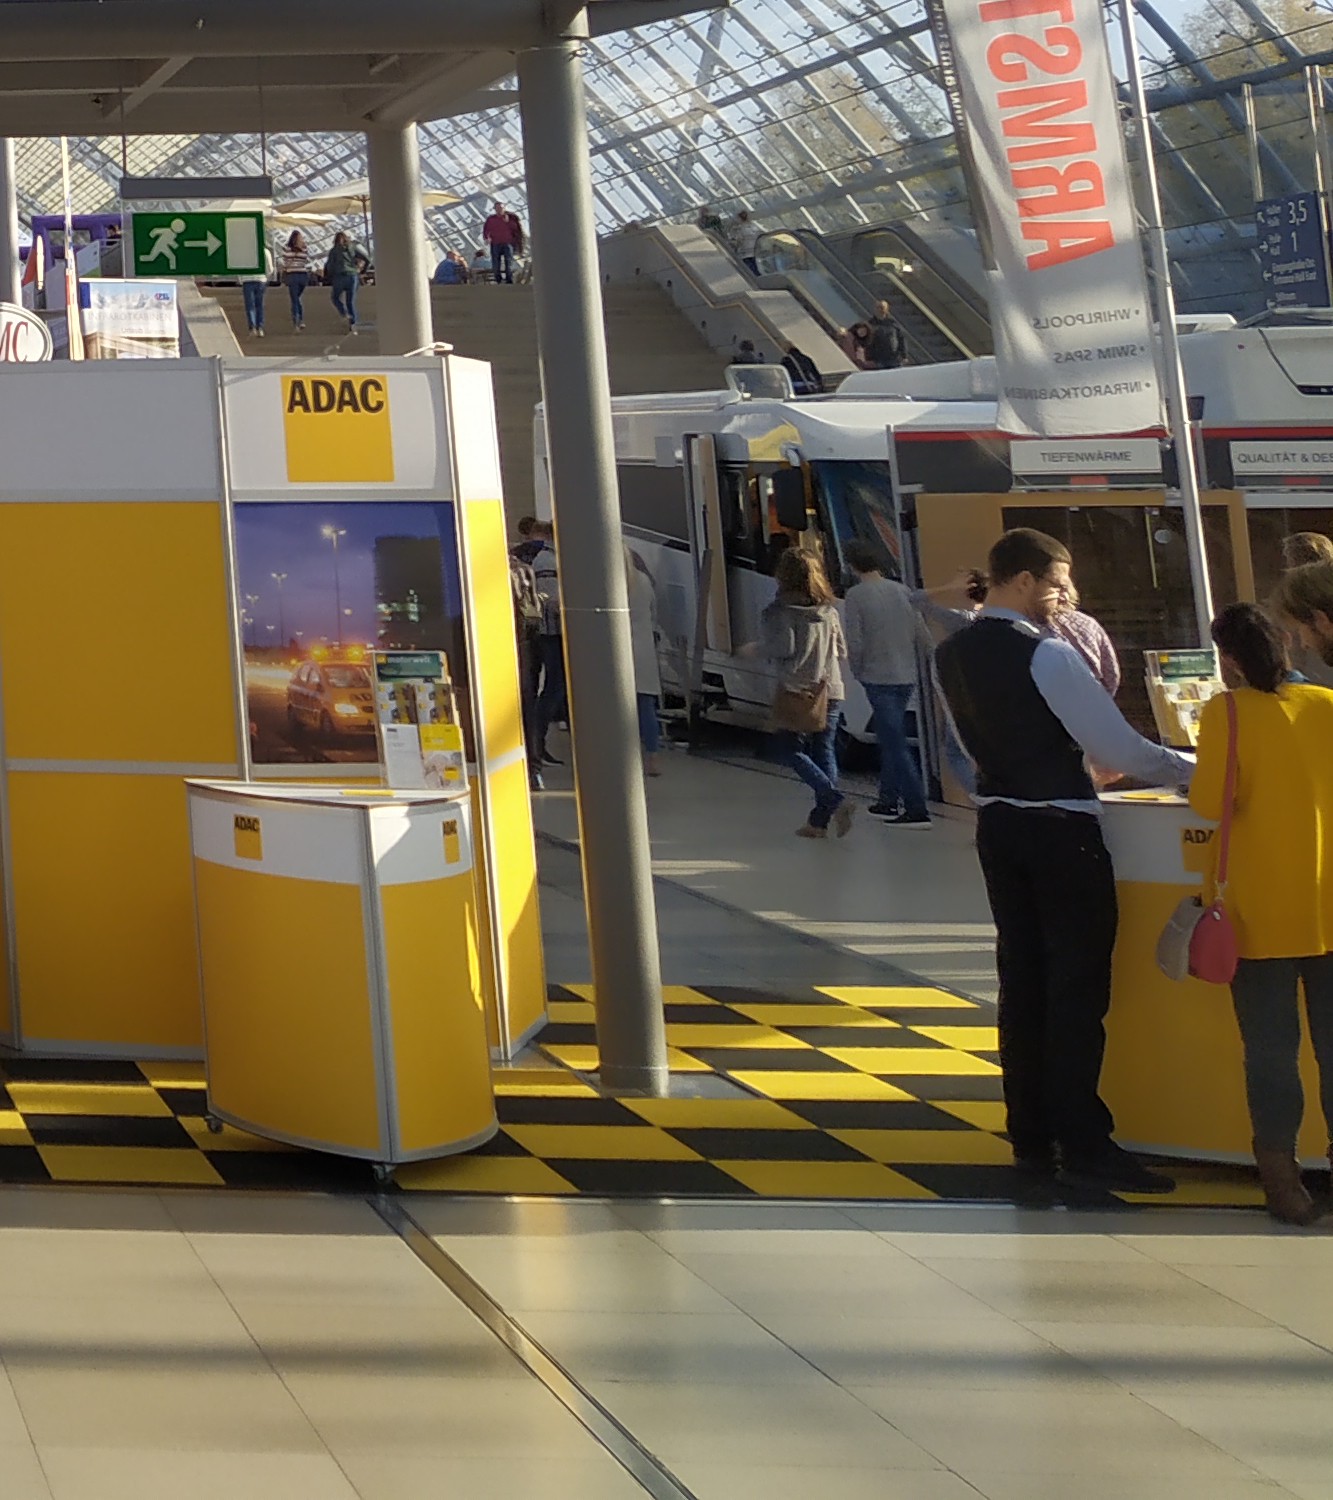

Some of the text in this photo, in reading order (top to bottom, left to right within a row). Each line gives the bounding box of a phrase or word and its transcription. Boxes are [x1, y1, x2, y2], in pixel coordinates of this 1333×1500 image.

[287, 379, 385, 413] ADAC
[1039, 450, 1133, 463] TIEFENWÄRME
[1236, 451, 1297, 465] QUALITÄT
[1300, 453, 1310, 463] &
[235, 816, 261, 832] ADAC
